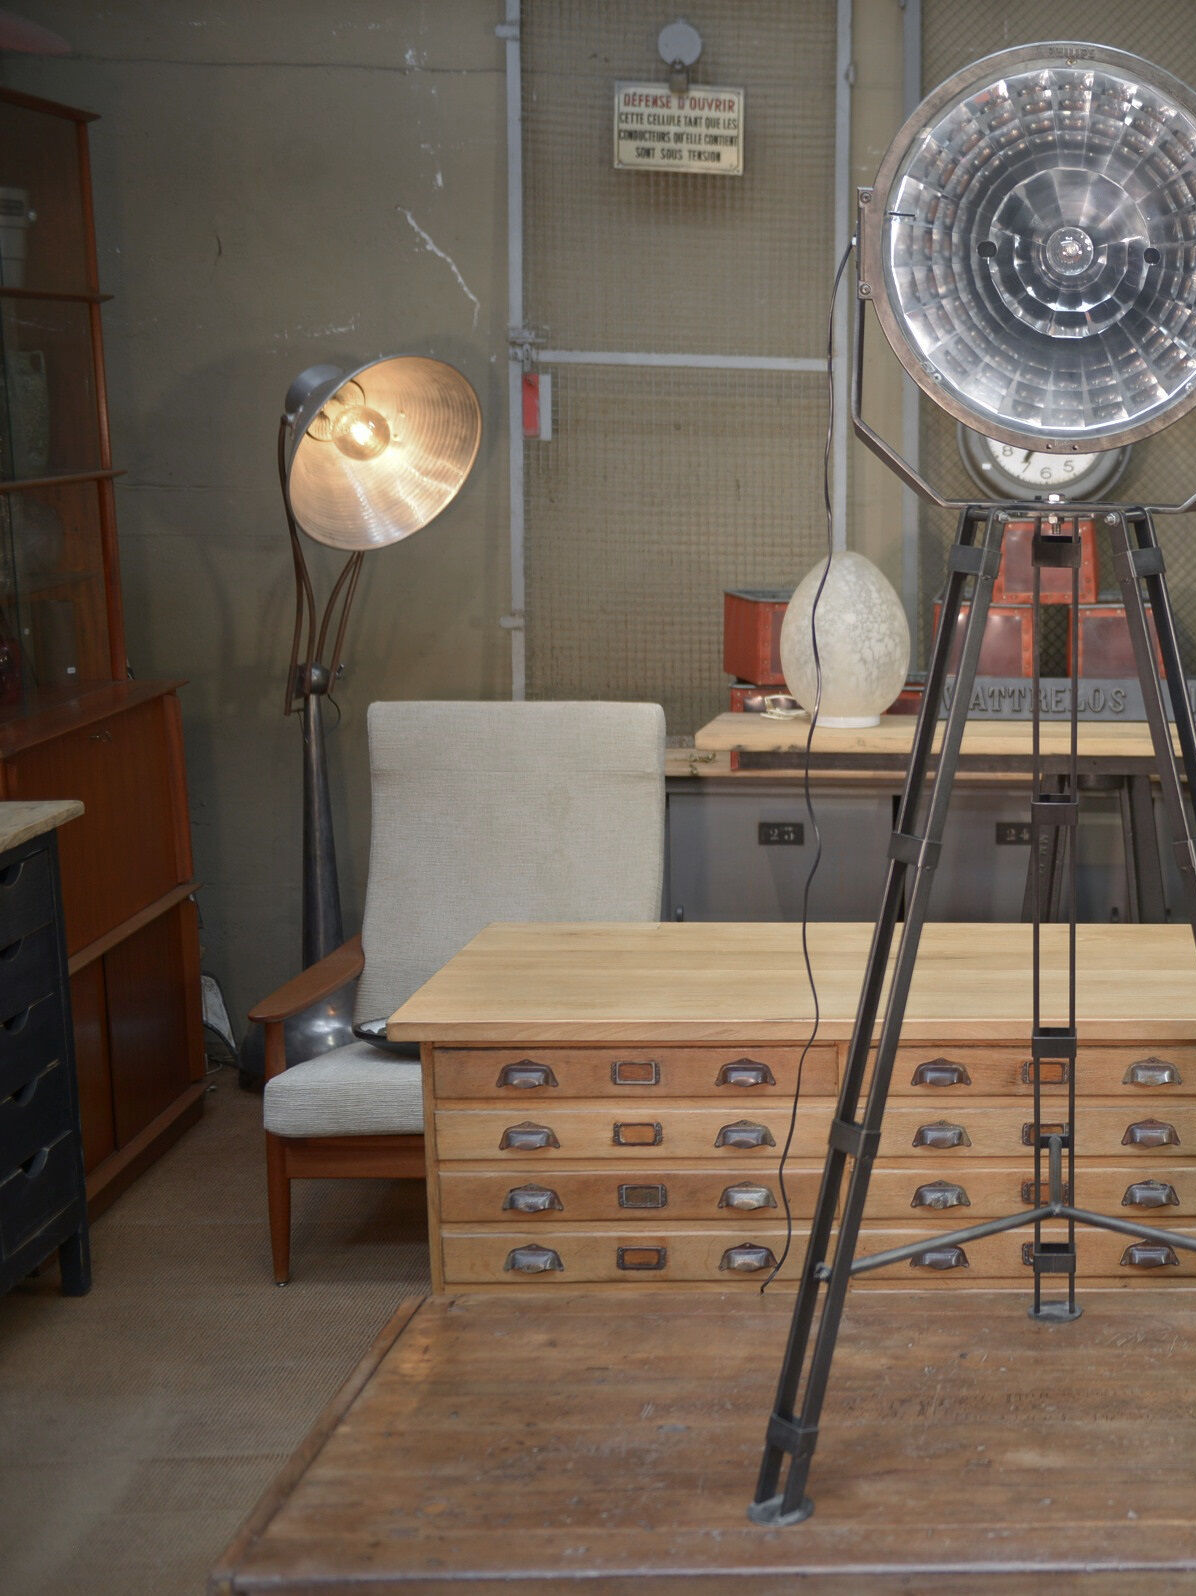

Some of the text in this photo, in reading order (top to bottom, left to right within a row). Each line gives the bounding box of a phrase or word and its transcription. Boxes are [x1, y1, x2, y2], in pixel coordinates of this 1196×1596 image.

[624, 92, 735, 113] DÉFENSE D'OUVRIR
[619, 112, 737, 130] CETTE CELLULE TANT QUE LES
[619, 130, 738, 147] CONDUCTEURS QU'ELLE CONTIENT
[636, 147, 721, 162] SONT SOUS TENSION
[1002, 445, 1014, 457] 8
[1062, 459, 1075, 473] 5
[1040, 467, 1053, 480] 6
[1006, 827, 1030, 841] 24
